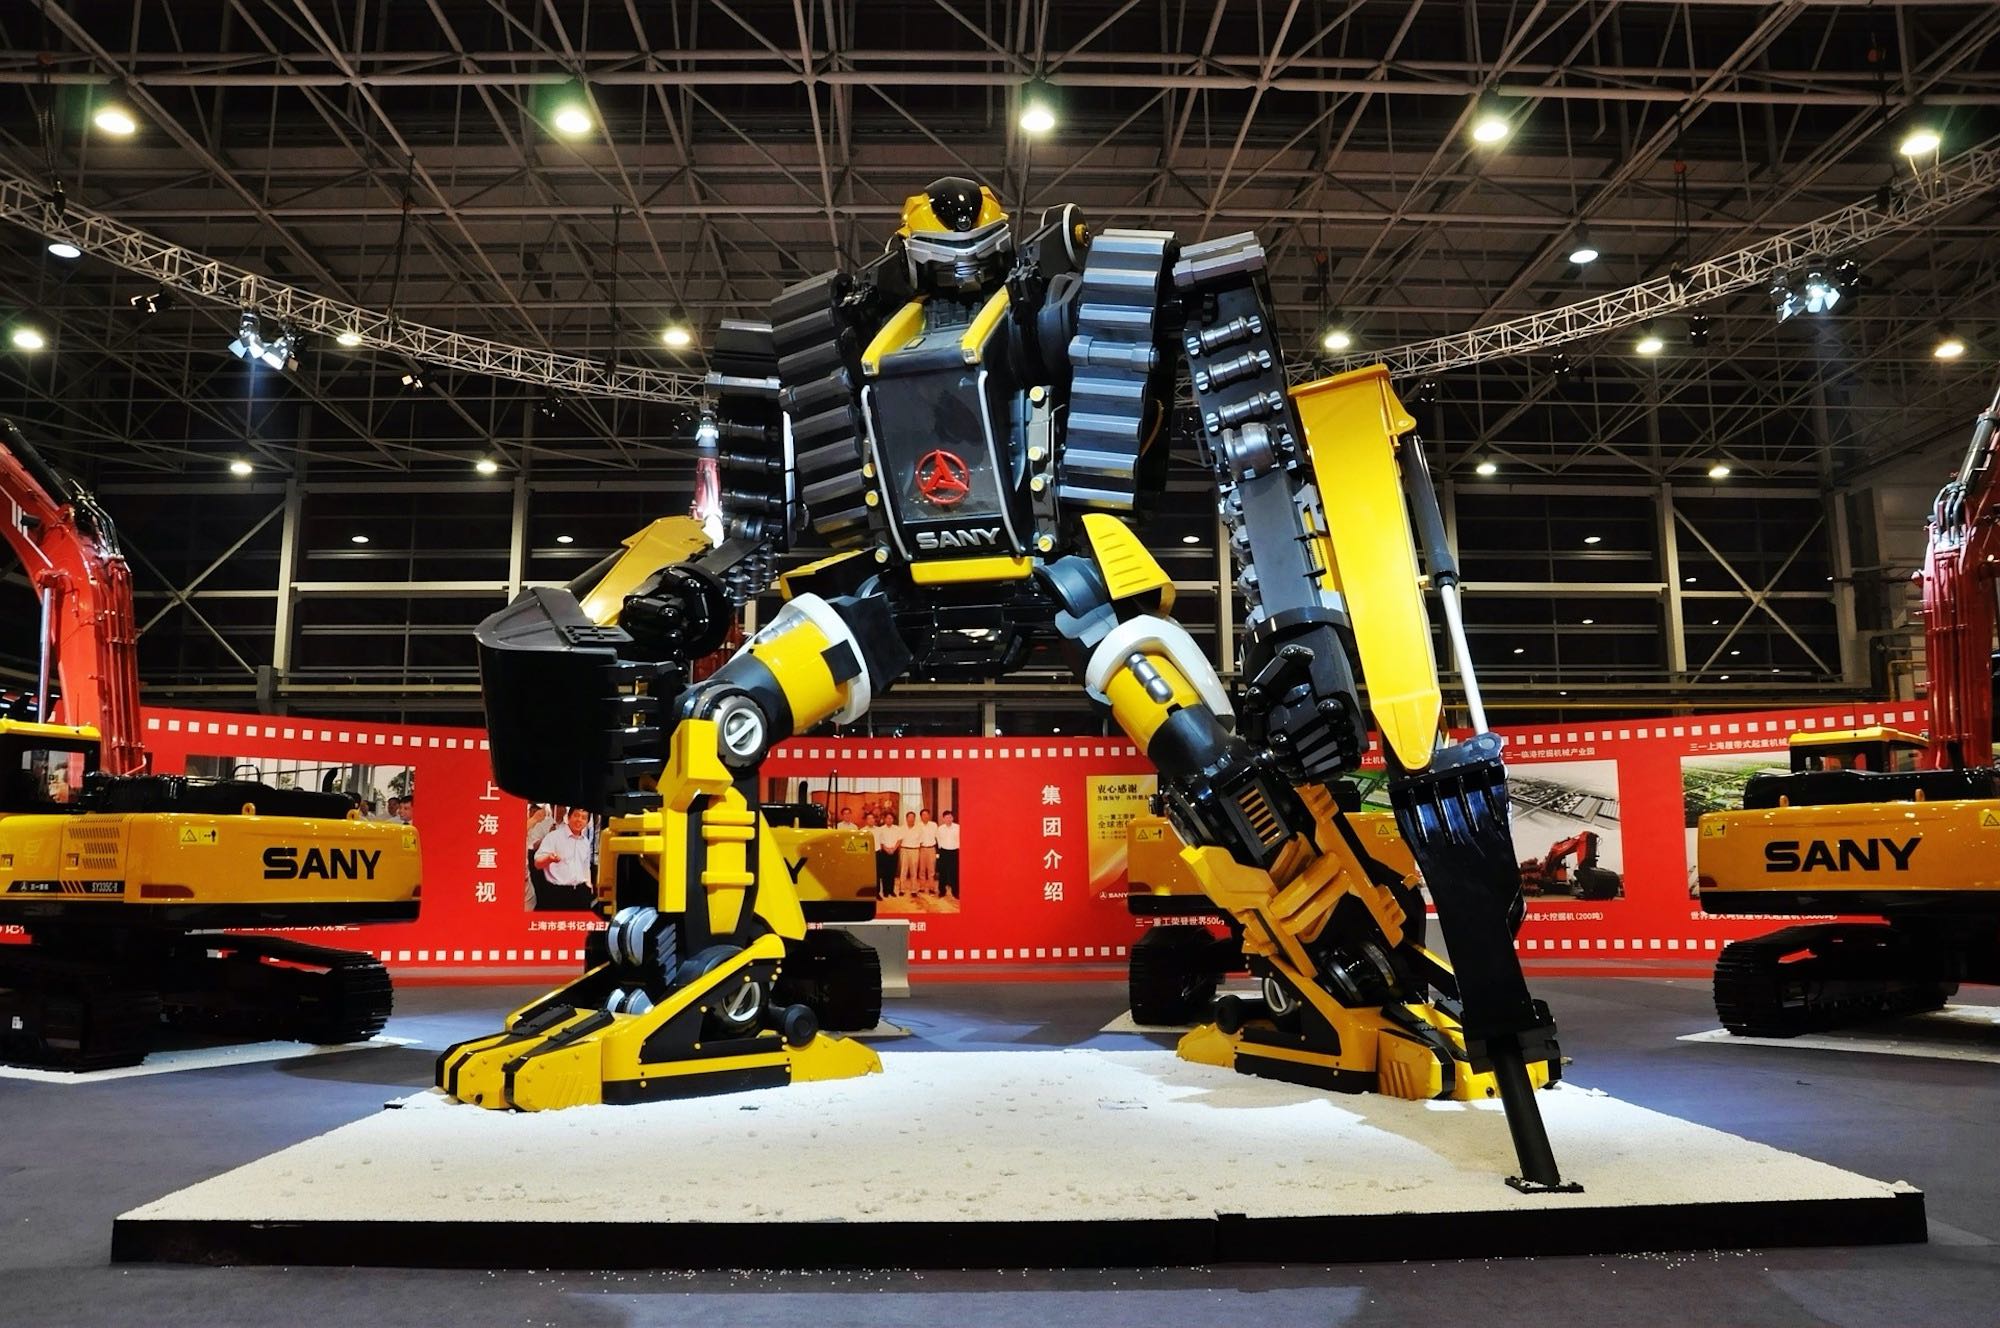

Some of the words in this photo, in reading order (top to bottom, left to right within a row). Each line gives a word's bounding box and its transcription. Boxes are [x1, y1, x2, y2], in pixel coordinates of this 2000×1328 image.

[916, 527, 1001, 550] SANY
[1689, 737, 1790, 752] 三一上海履带式起重机械
[475, 780, 501, 903] 上海重视
[1041, 784, 1064, 902] 集团介绍
[1765, 837, 1922, 872] SANY
[261, 847, 382, 880] SANY
